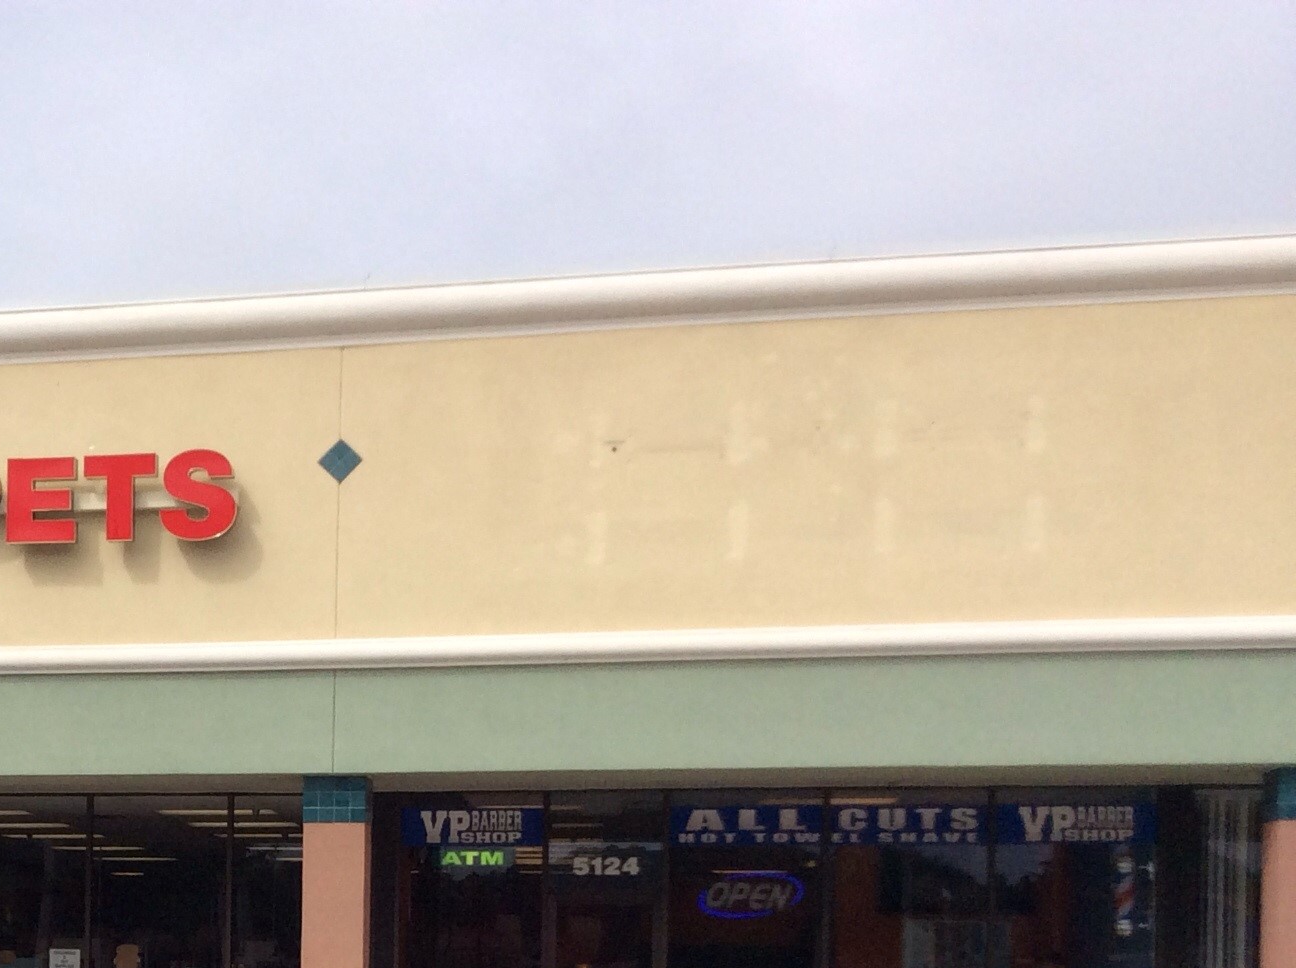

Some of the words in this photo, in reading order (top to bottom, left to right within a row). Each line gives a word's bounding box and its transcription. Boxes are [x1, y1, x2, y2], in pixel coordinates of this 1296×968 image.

[420, 810, 470, 843] VP
[471, 810, 522, 831] BARBER
[685, 808, 807, 832] ALL
[837, 807, 979, 831] CUTS
[1018, 806, 1076, 842] VP
[461, 832, 522, 843] SHOP
[678, 832, 736, 843] HOT
[1064, 829, 1135, 842] SHOP
[441, 851, 504, 865] ATM
[572, 857, 640, 876] 5124
[707, 881, 793, 910] OPEN
